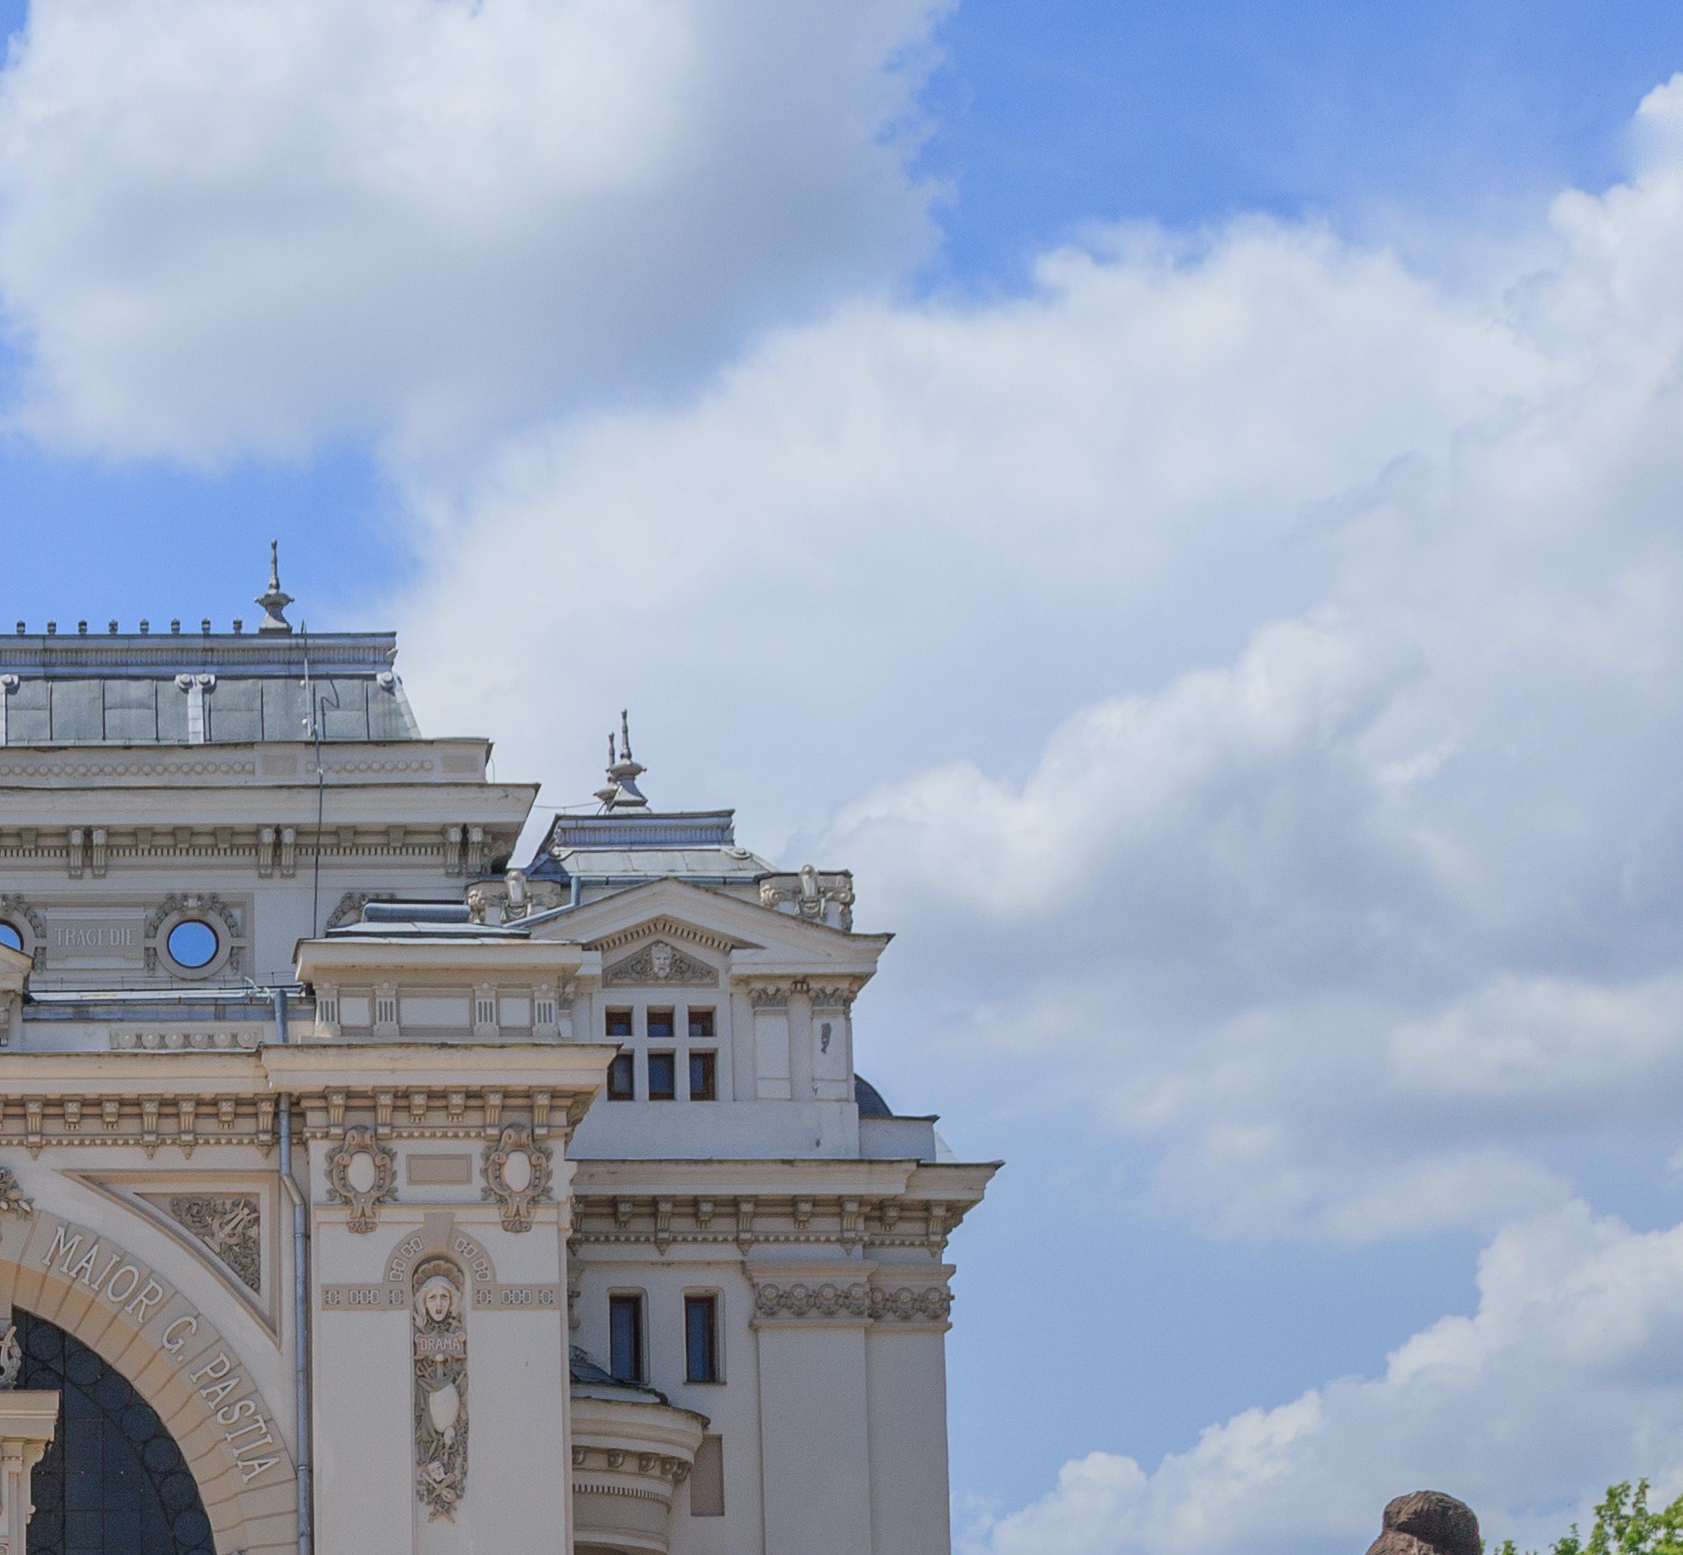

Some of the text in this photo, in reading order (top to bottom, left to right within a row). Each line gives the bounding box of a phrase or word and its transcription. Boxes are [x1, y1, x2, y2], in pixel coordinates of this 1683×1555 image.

[55, 928, 136, 946] TRAGEDIE
[420, 1338, 461, 1351] DRAMA
[41, 1226, 279, 1484] MAIOR G. PASTIA
